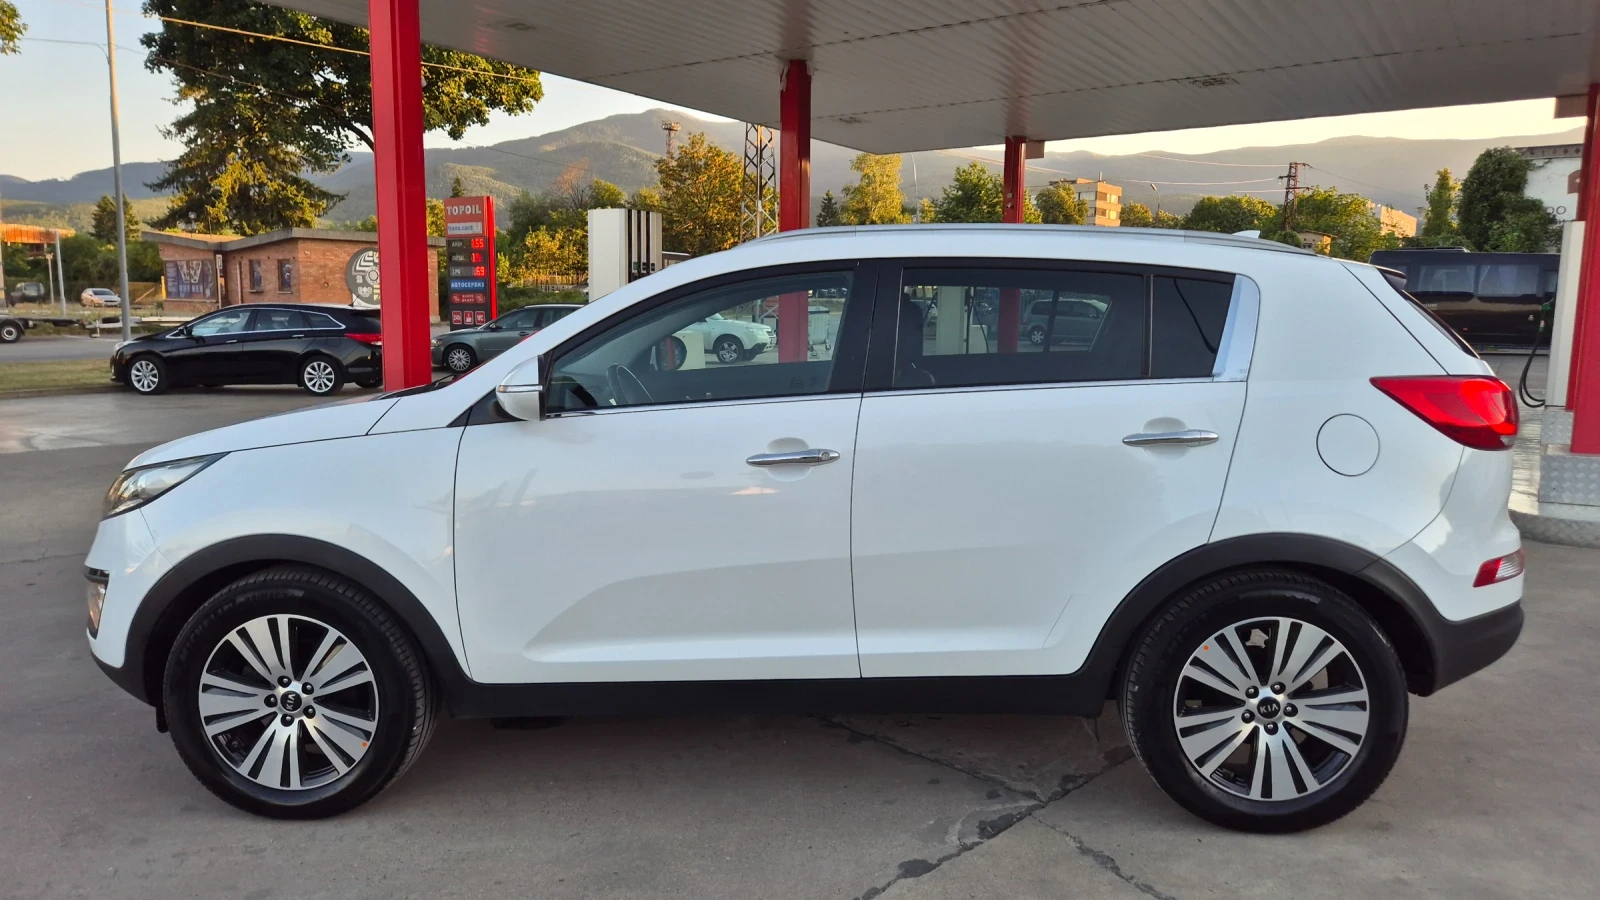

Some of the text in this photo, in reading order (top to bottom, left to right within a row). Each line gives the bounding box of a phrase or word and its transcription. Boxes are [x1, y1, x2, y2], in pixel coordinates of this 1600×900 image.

[446, 204, 481, 215] TOPOIL
[286, 693, 296, 710] KIA
[1260, 703, 1278, 713] KIA
